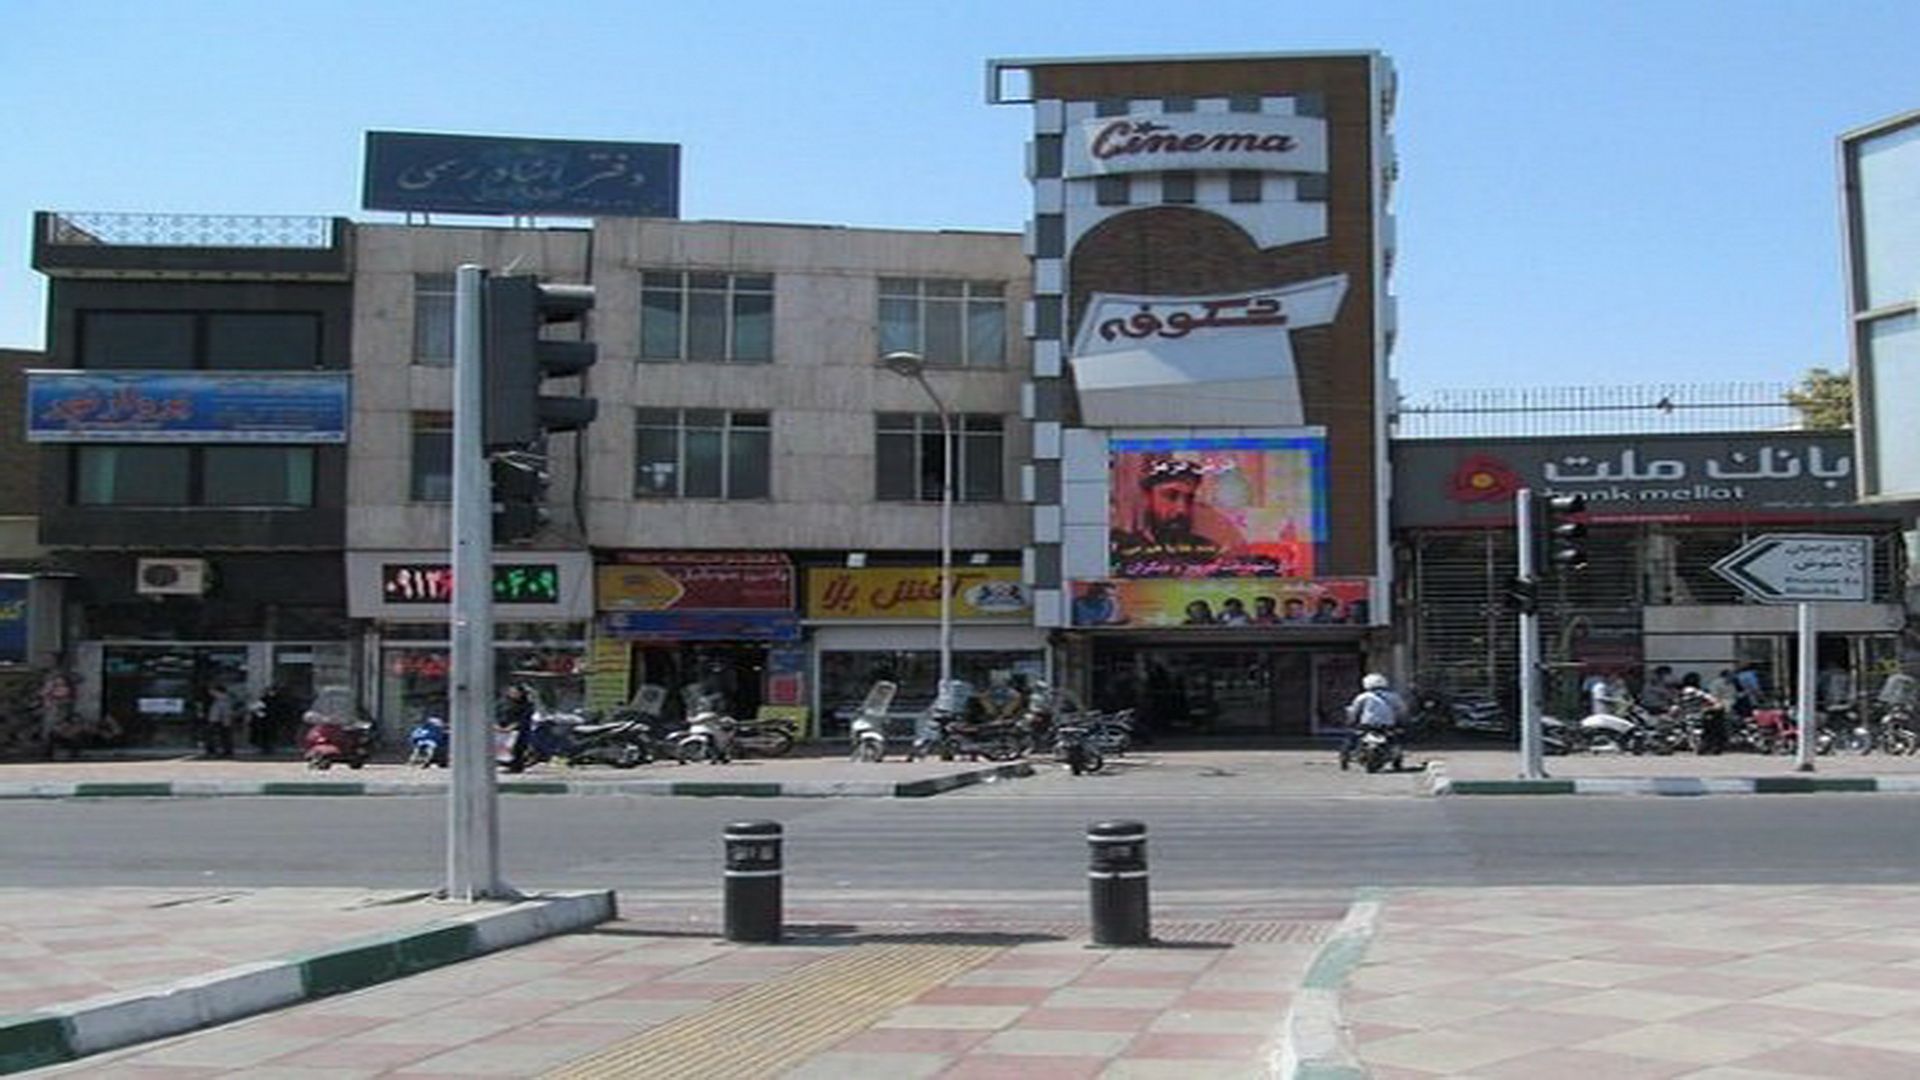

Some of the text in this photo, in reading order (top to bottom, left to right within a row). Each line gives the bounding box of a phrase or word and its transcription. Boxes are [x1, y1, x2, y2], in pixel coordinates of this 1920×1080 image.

[1092, 120, 1299, 159] Cinema
[569, 152, 646, 191] دفتر
[1100, 298, 1287, 341] شکوفه
[1544, 449, 1686, 481] ملت
[1639, 483, 1745, 501] mellat
